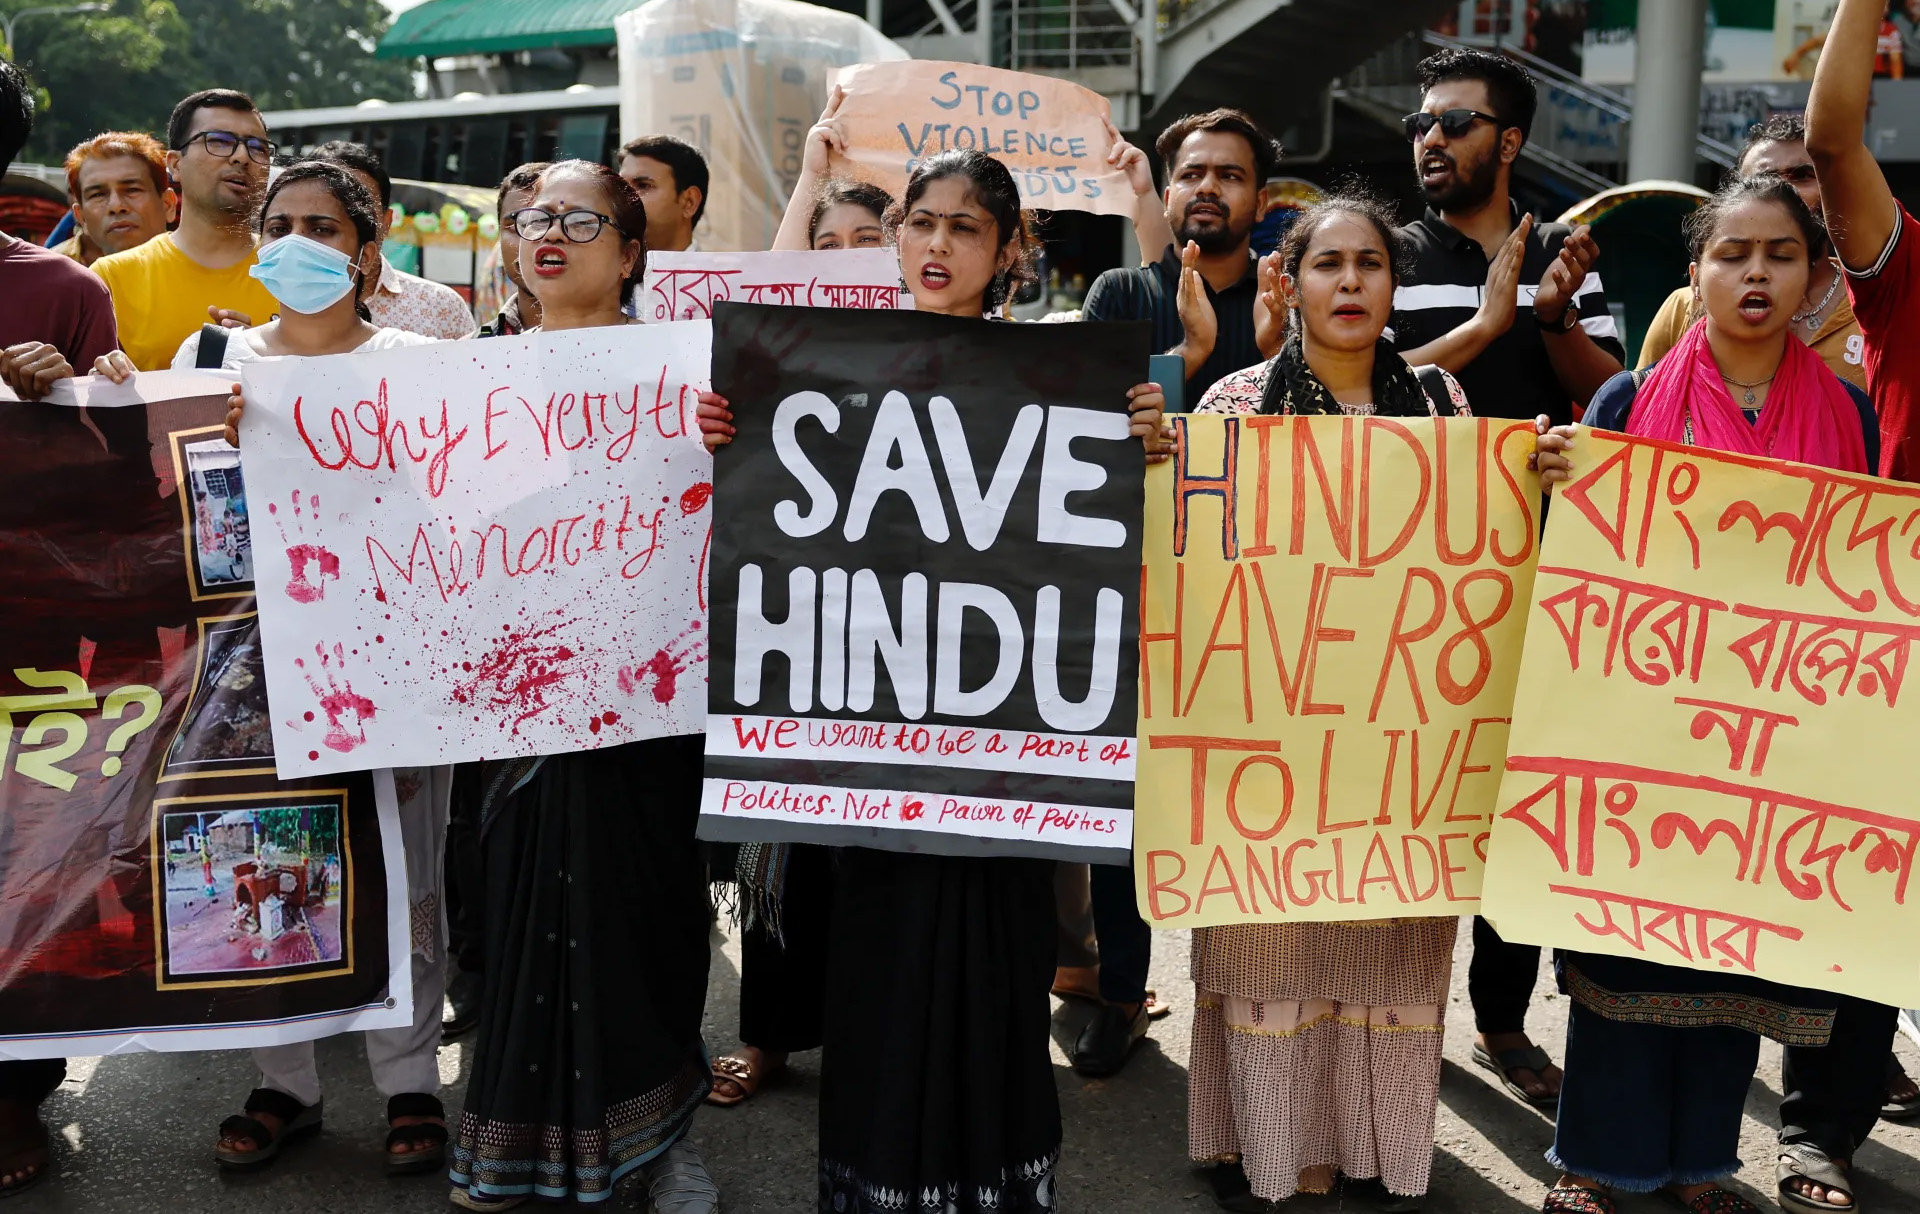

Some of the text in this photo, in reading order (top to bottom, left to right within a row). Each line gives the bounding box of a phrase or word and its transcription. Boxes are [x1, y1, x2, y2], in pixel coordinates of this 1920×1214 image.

[931, 71, 1040, 120] STOP
[294, 377, 468, 498] Why
[772, 390, 1131, 552] SAVE
[1172, 416, 1539, 567] HINDUS
[734, 563, 1123, 731] HINDU
[1139, 561, 1375, 724] HAVE
[808, 721, 888, 750] want
[985, 733, 1008, 754] a
[1149, 717, 1509, 846] TO LIVE
[1674, 697, 1798, 776] না
[842, 792, 893, 820] Not
